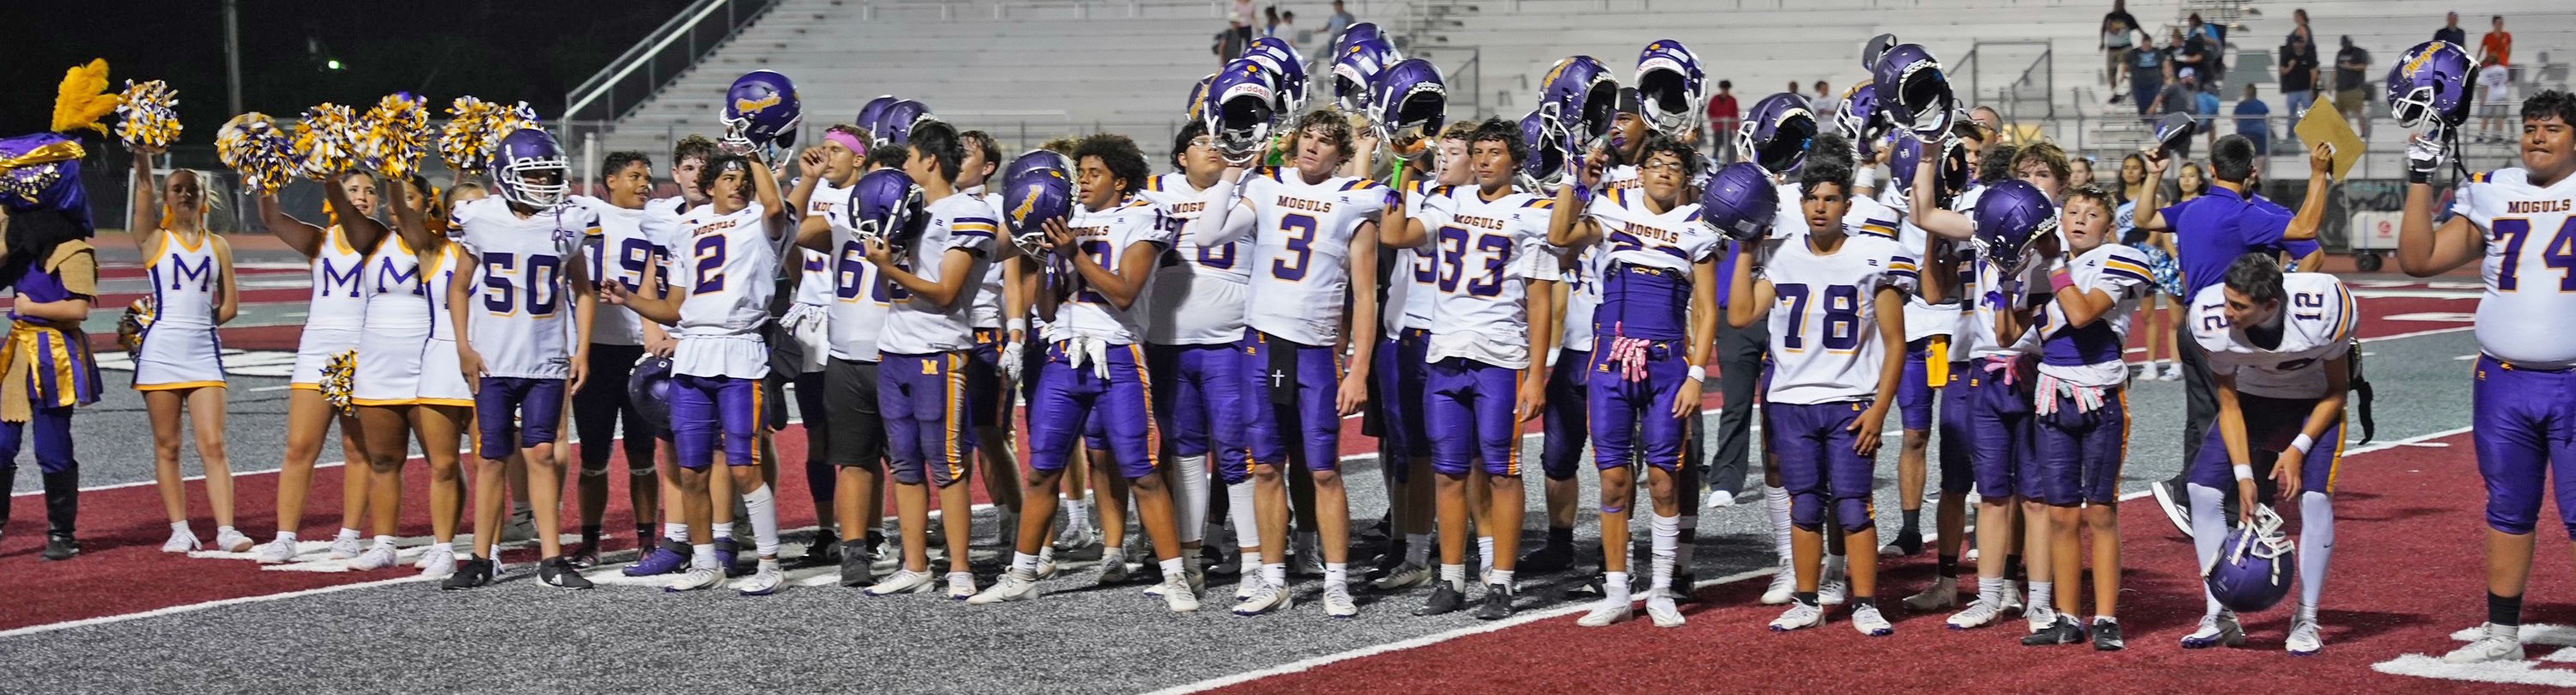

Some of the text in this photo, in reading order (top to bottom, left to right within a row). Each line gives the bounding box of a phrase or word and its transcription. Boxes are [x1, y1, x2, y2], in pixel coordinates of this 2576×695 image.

[1277, 195, 1332, 213] MOGULS
[2506, 198, 2571, 213] MOGULS
[692, 219, 737, 238] MOGULS
[1454, 214, 1504, 230] MOGULS
[1624, 221, 1680, 243] MOGULS
[1272, 213, 1318, 282] 3
[1438, 225, 1513, 297] 33
[2491, 216, 2576, 293] 74
[172, 253, 211, 292] M
[323, 257, 364, 298] M
[378, 256, 425, 296] M
[693, 234, 726, 296] 2
[483, 252, 562, 319] 50
[1775, 283, 1862, 354] 78
[2202, 303, 2230, 332] 12
[2294, 292, 2324, 321] 12
[975, 331, 992, 344] M
[921, 359, 939, 375] M
